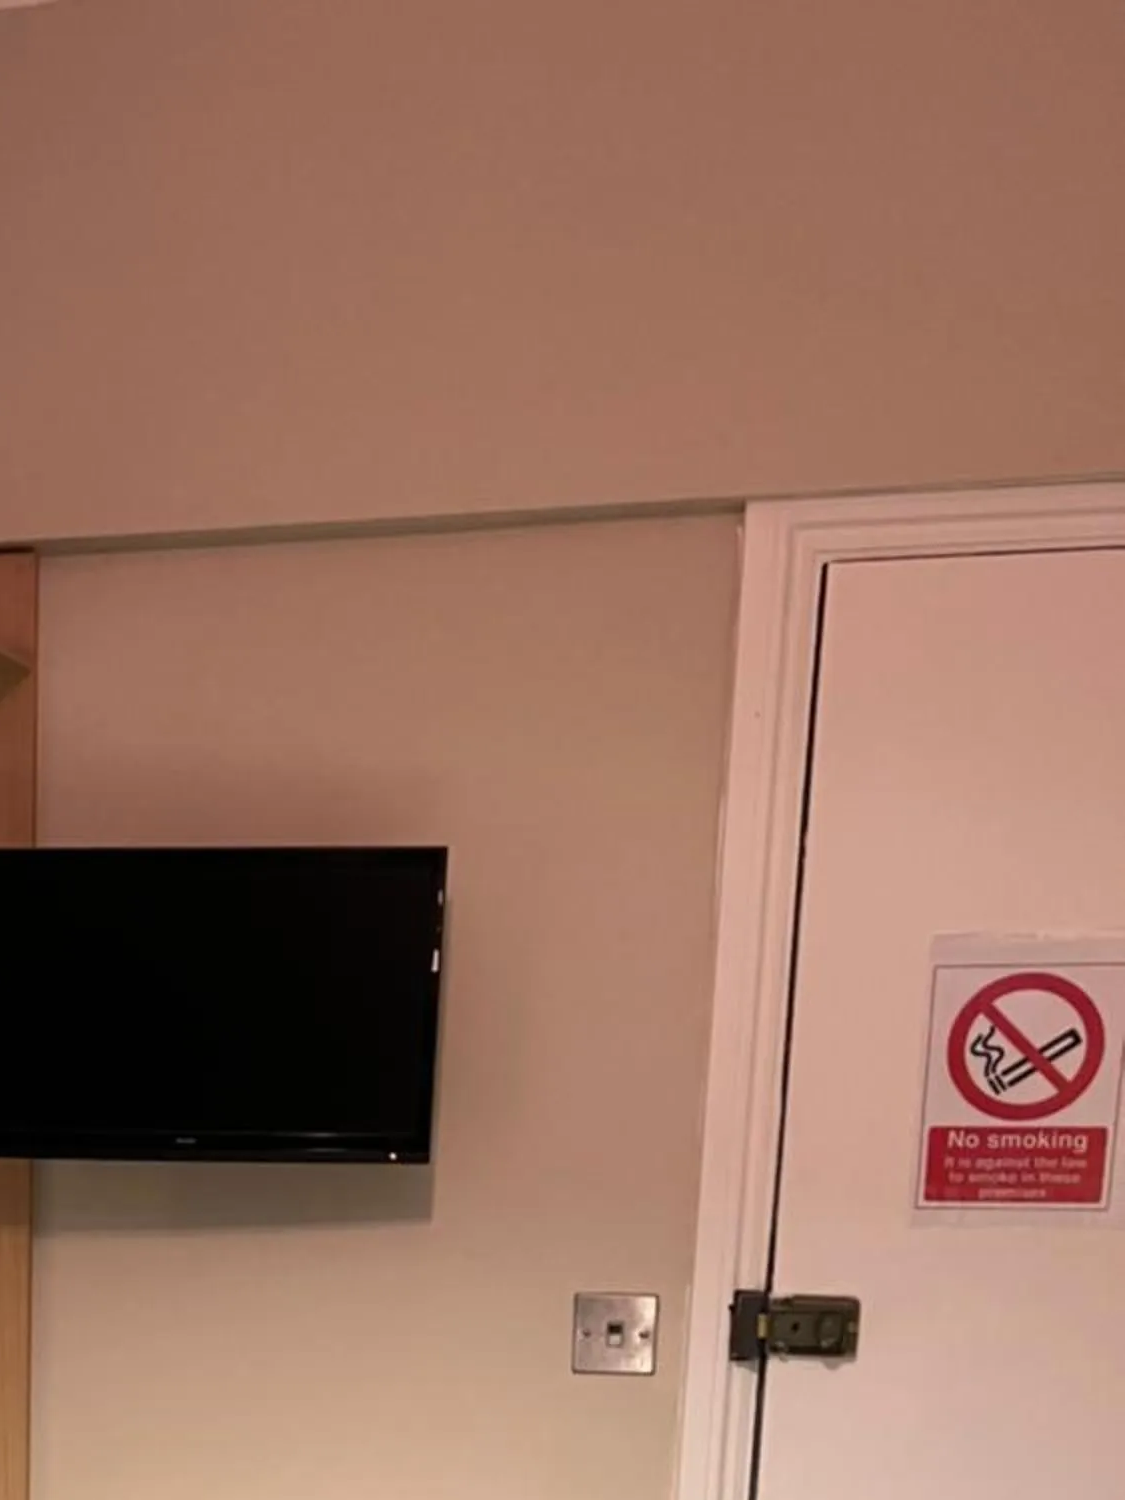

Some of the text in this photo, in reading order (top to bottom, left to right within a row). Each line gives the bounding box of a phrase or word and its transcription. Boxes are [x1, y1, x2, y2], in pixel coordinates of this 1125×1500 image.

[947, 1130, 1088, 1155] No smoking
[1034, 1156, 1058, 1168] the
